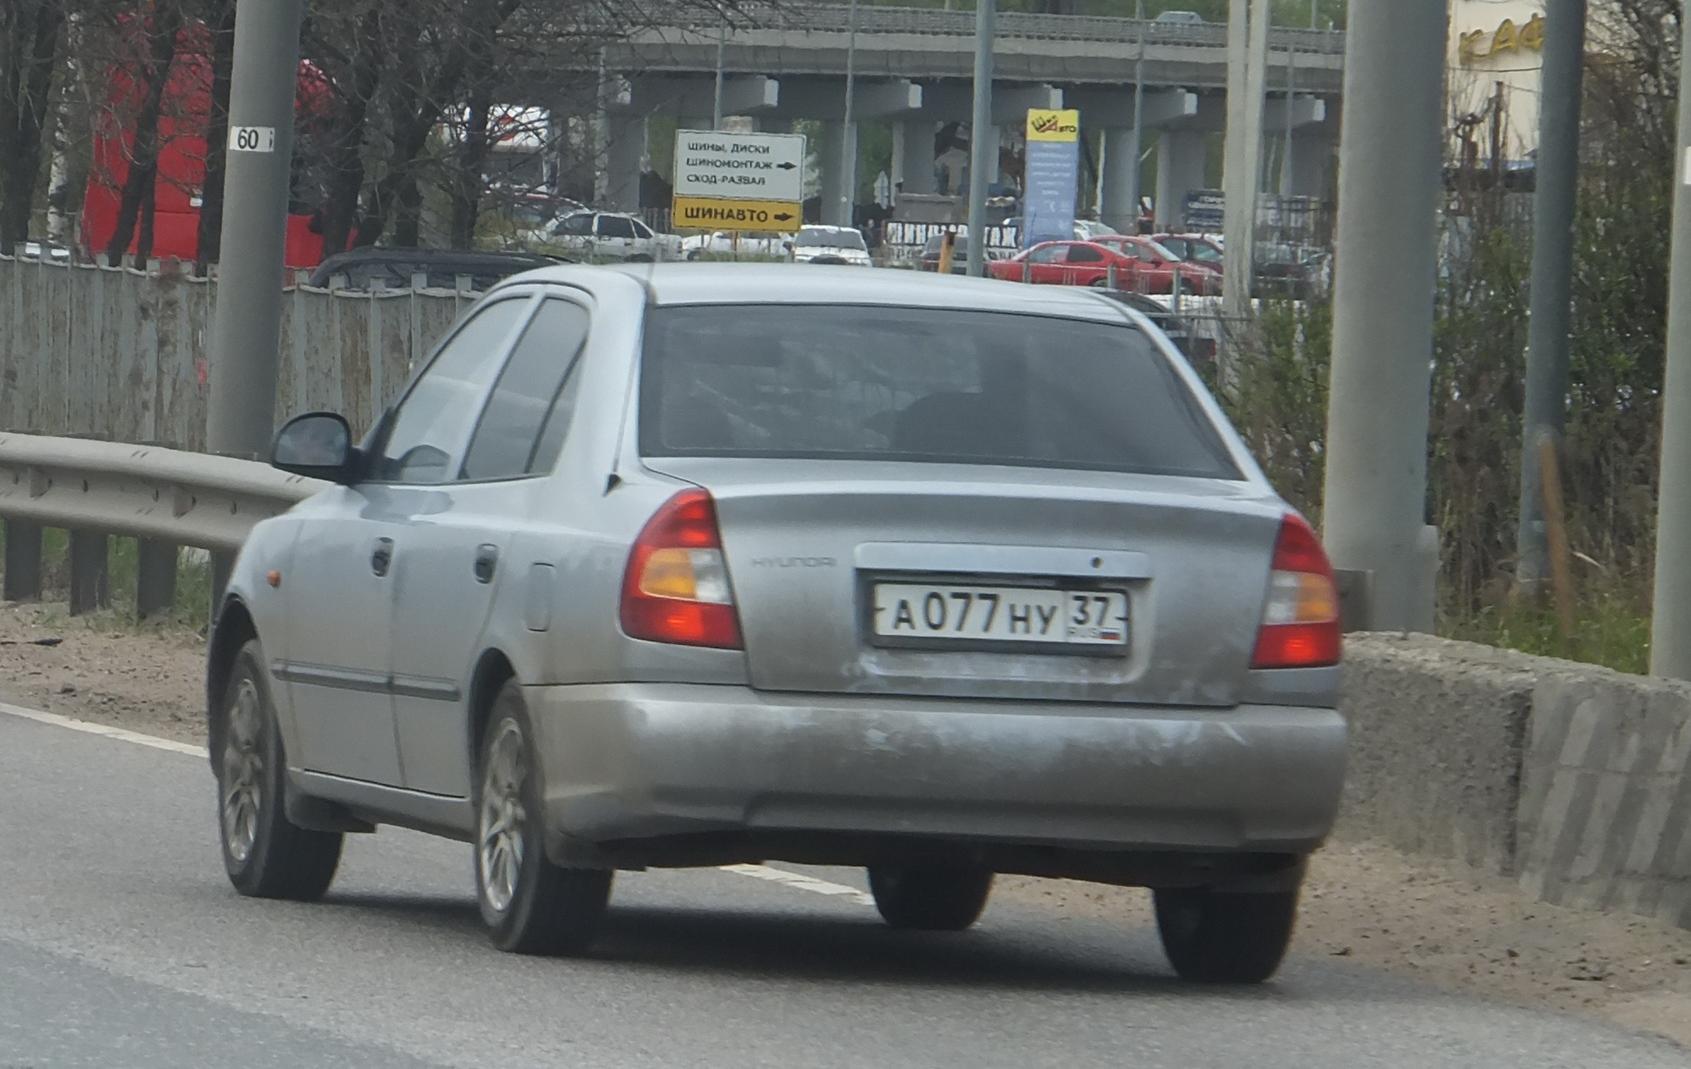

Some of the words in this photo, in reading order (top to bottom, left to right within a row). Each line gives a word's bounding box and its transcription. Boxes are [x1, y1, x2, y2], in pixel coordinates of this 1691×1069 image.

[238, 129, 259, 149] 60
[688, 142, 727, 152] ШИНЫ,
[731, 143, 770, 154] ДИСКИ
[686, 157, 773, 169] ШИНОМОНТАЖ
[686, 174, 766, 185] СХОД-РАЗВАЛ
[685, 207, 768, 222] ШИНАВТО
[1072, 595, 1111, 627] 37
